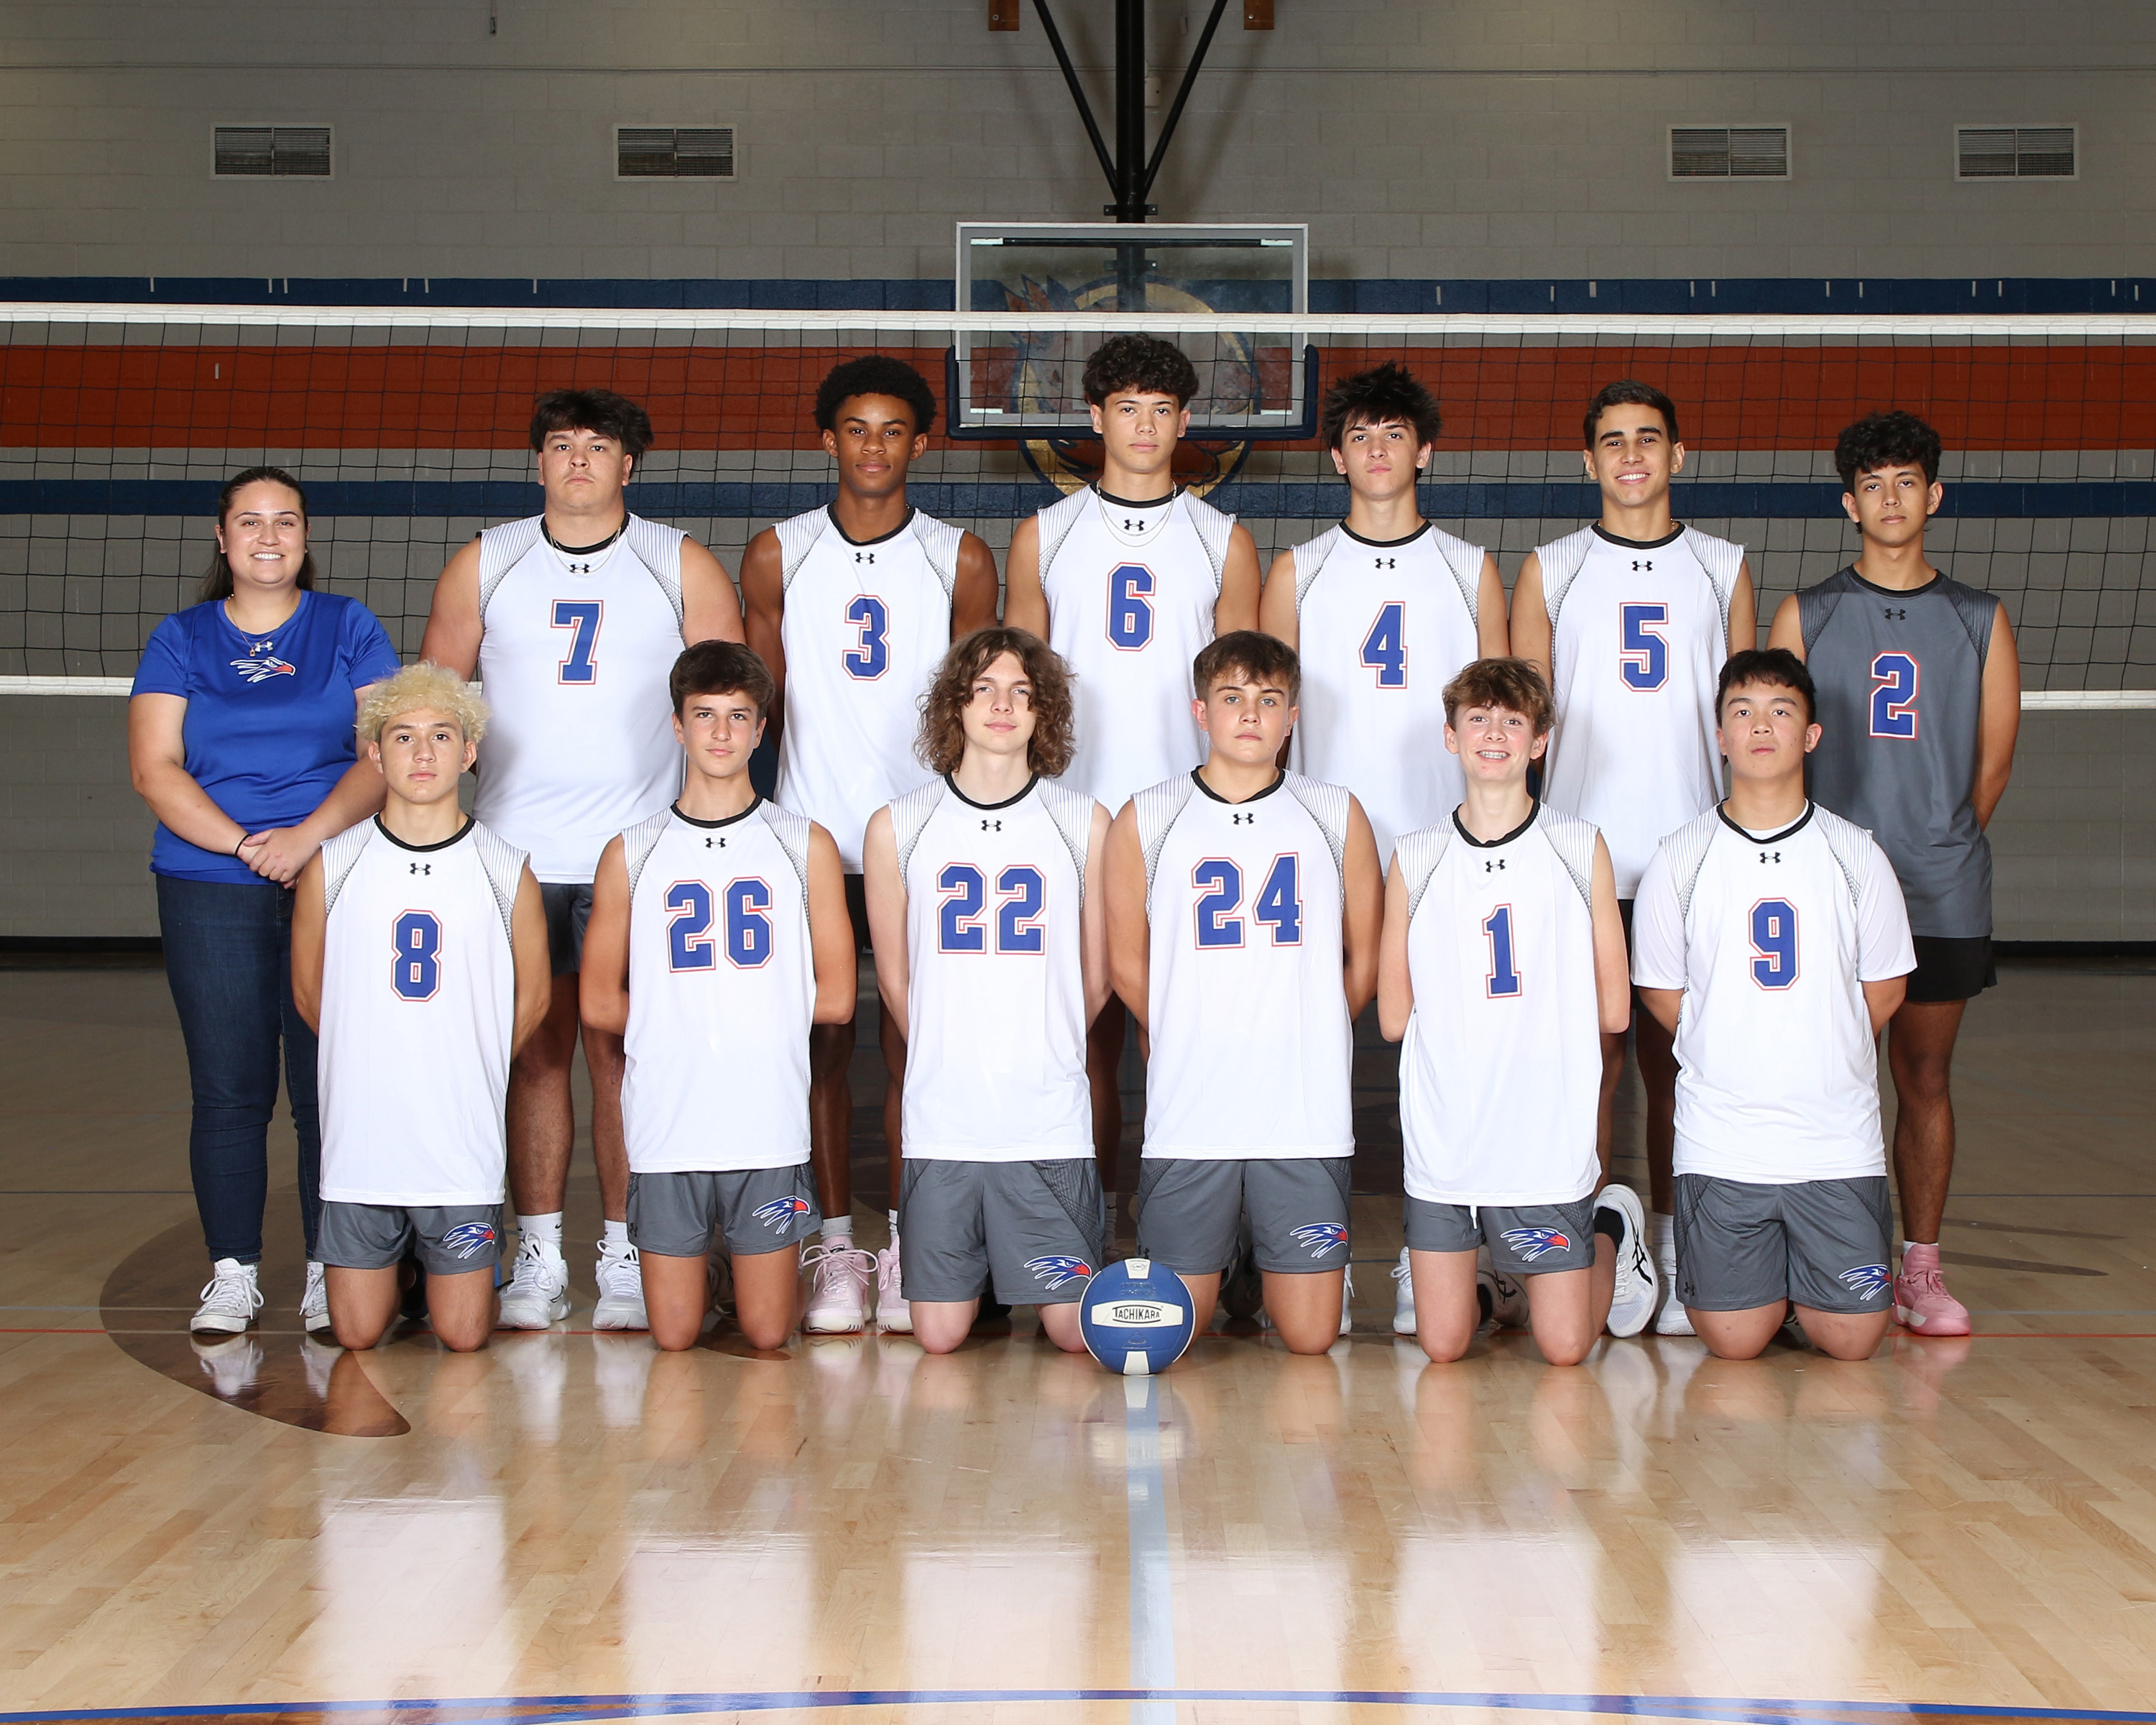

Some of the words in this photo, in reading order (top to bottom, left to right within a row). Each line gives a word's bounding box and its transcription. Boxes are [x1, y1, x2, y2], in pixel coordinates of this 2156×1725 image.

[550, 599, 604, 685] 7
[842, 594, 890, 681] 3
[1106, 562, 1156, 652] 6
[1359, 600, 1408, 690] 4
[1619, 602, 1669, 692] 5
[1868, 650, 1920, 740] 2
[664, 876, 773, 973] 26
[937, 862, 1046, 955] 22
[1192, 852, 1303, 950] 24
[1748, 897, 1800, 990] 9
[391, 908, 443, 1002] 8
[1482, 903, 1522, 999] 1
[1112, 1306, 1161, 1320] TACHIKARA
